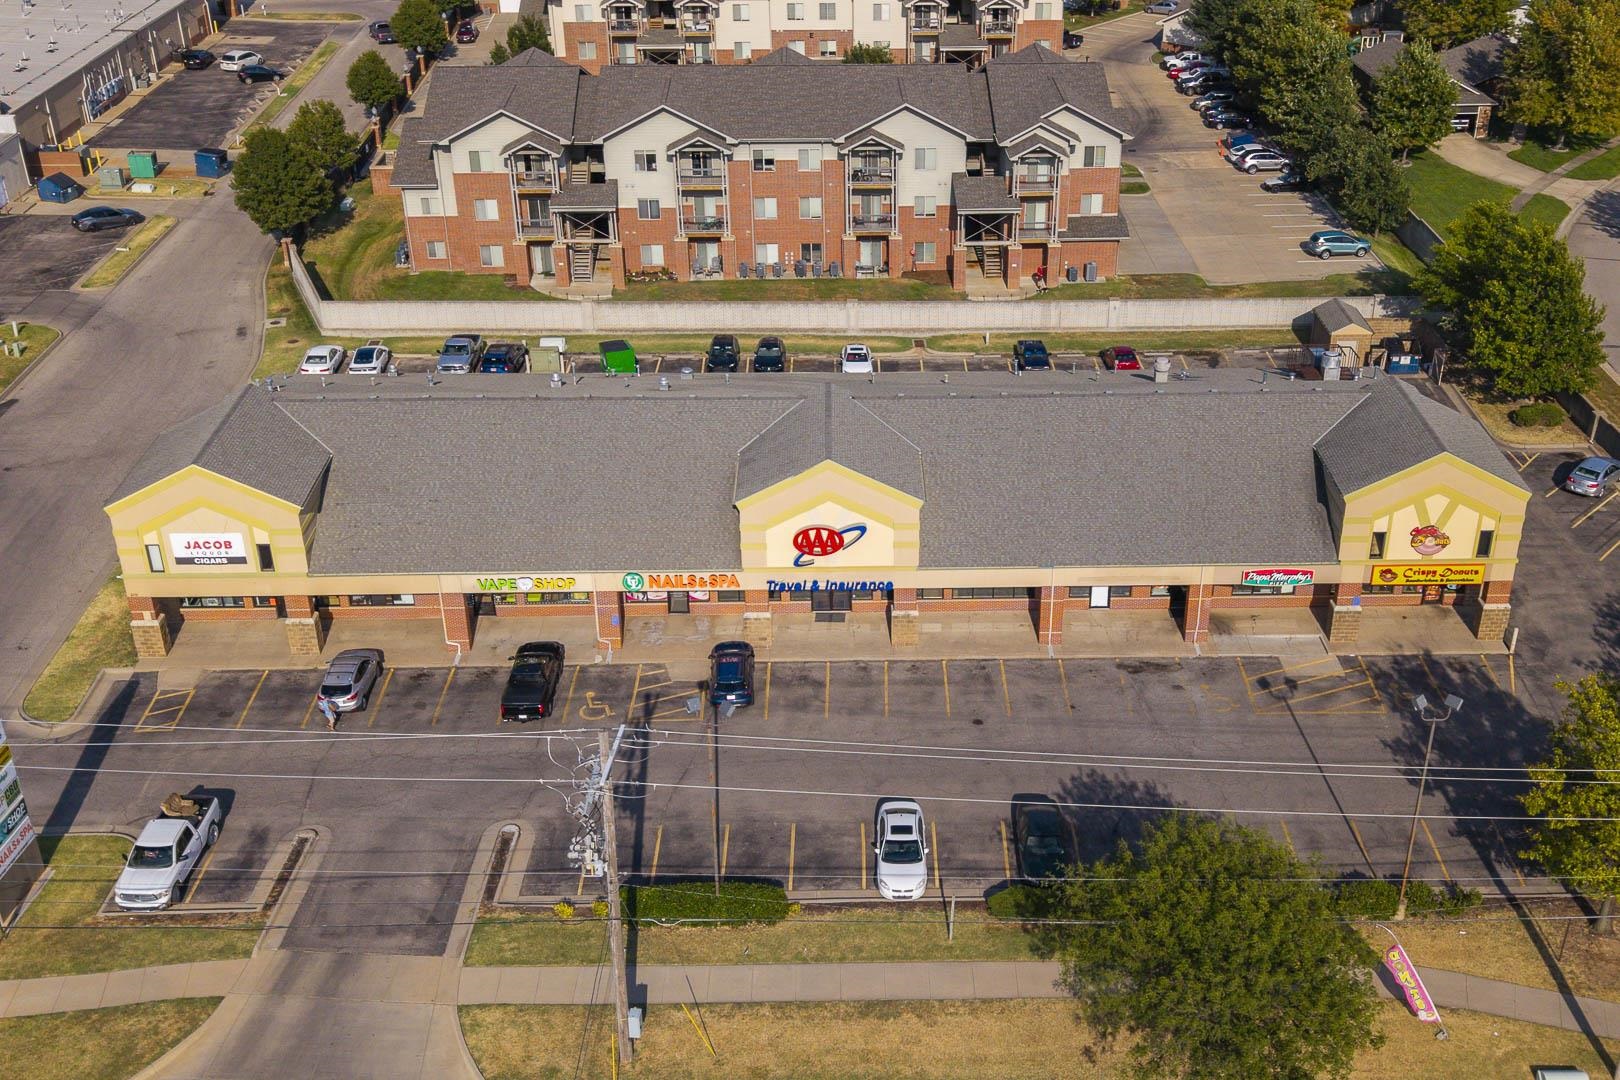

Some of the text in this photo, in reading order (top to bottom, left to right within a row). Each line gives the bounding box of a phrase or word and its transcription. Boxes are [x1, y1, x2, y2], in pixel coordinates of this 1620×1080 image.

[184, 540, 233, 550] JACOB
[794, 527, 844, 556] AAA
[1403, 568, 1479, 578] Crispy Donuts
[476, 577, 576, 591] VAPE SHOP
[767, 579, 894, 592] Travel & Insurance
[7, 802, 26, 831] SHOP
